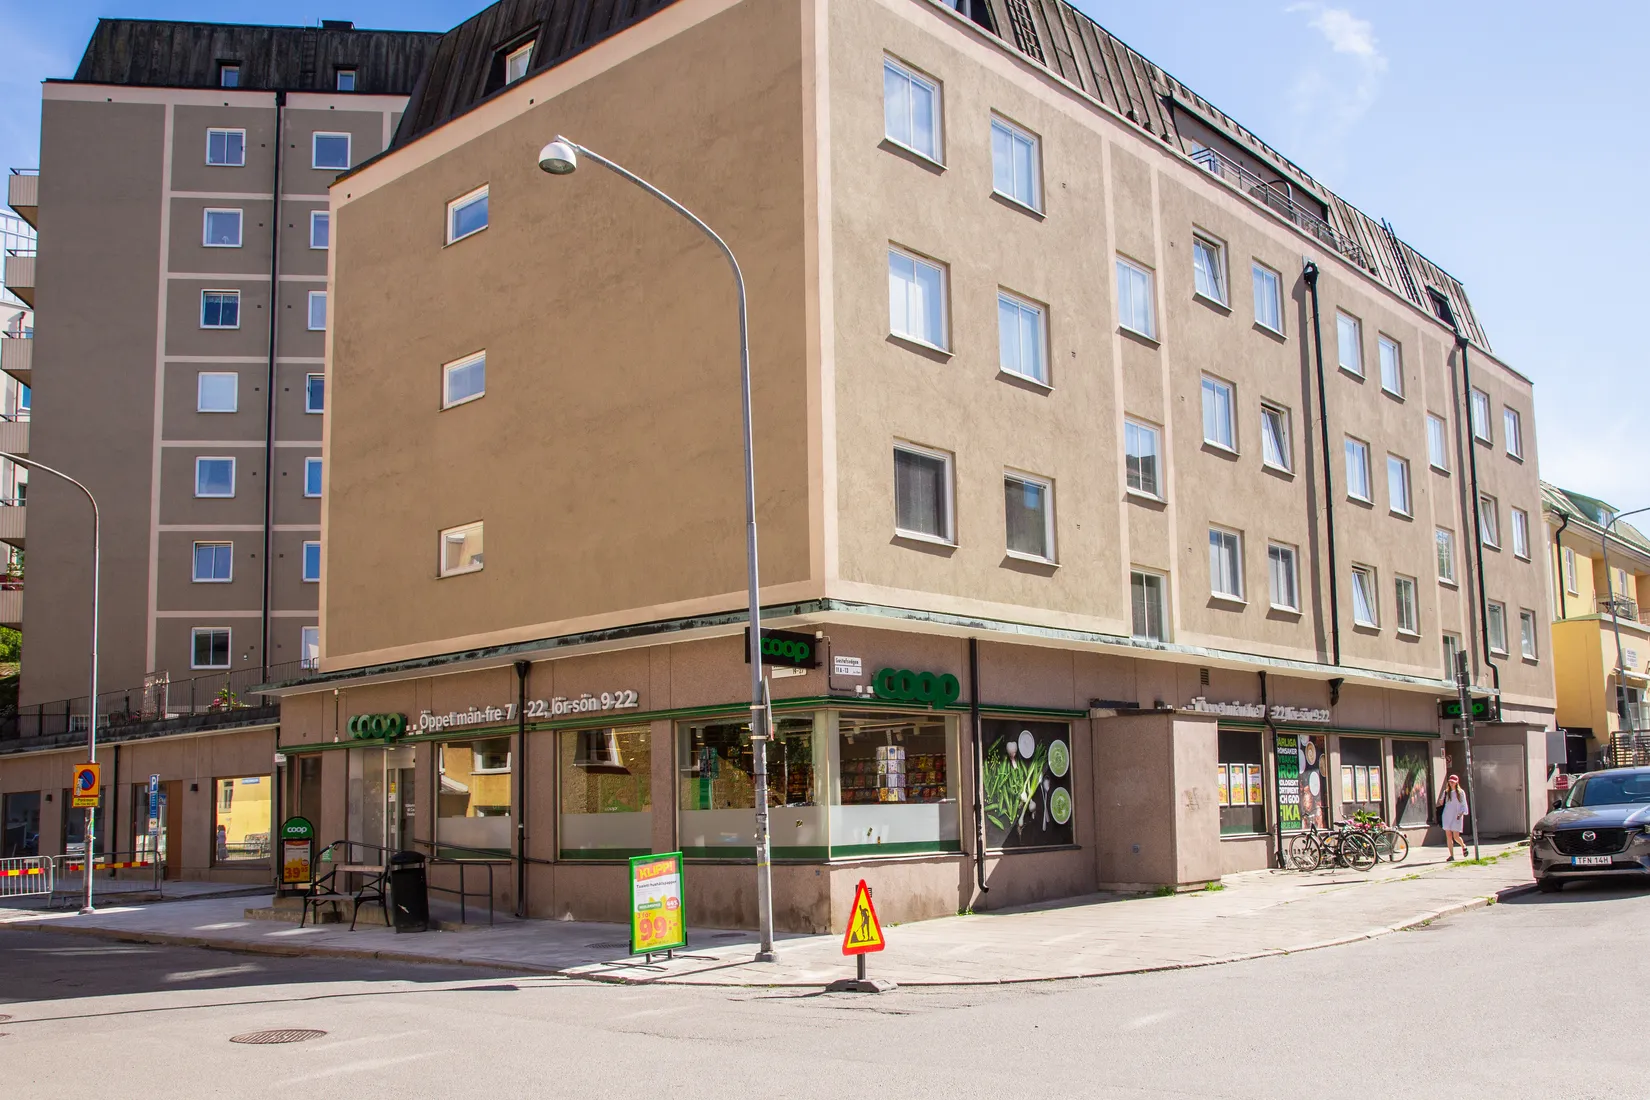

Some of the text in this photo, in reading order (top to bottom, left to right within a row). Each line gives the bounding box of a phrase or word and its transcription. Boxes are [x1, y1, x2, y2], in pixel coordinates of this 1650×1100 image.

[760, 637, 810, 663] coop
[872, 667, 960, 711] coop
[420, 709, 458, 732] Öppet
[456, 705, 506, 726] mån-fre
[551, 693, 602, 715] lör-sön
[600, 689, 638, 711] 9-22
[1447, 702, 1485, 716] cop
[347, 712, 407, 743] coop
[1277, 737, 1297, 747] ÄRLIGA
[151, 776, 157, 791] P
[287, 826, 308, 835] coop
[285, 866, 301, 879] 39
[639, 861, 673, 881] KLIPP!
